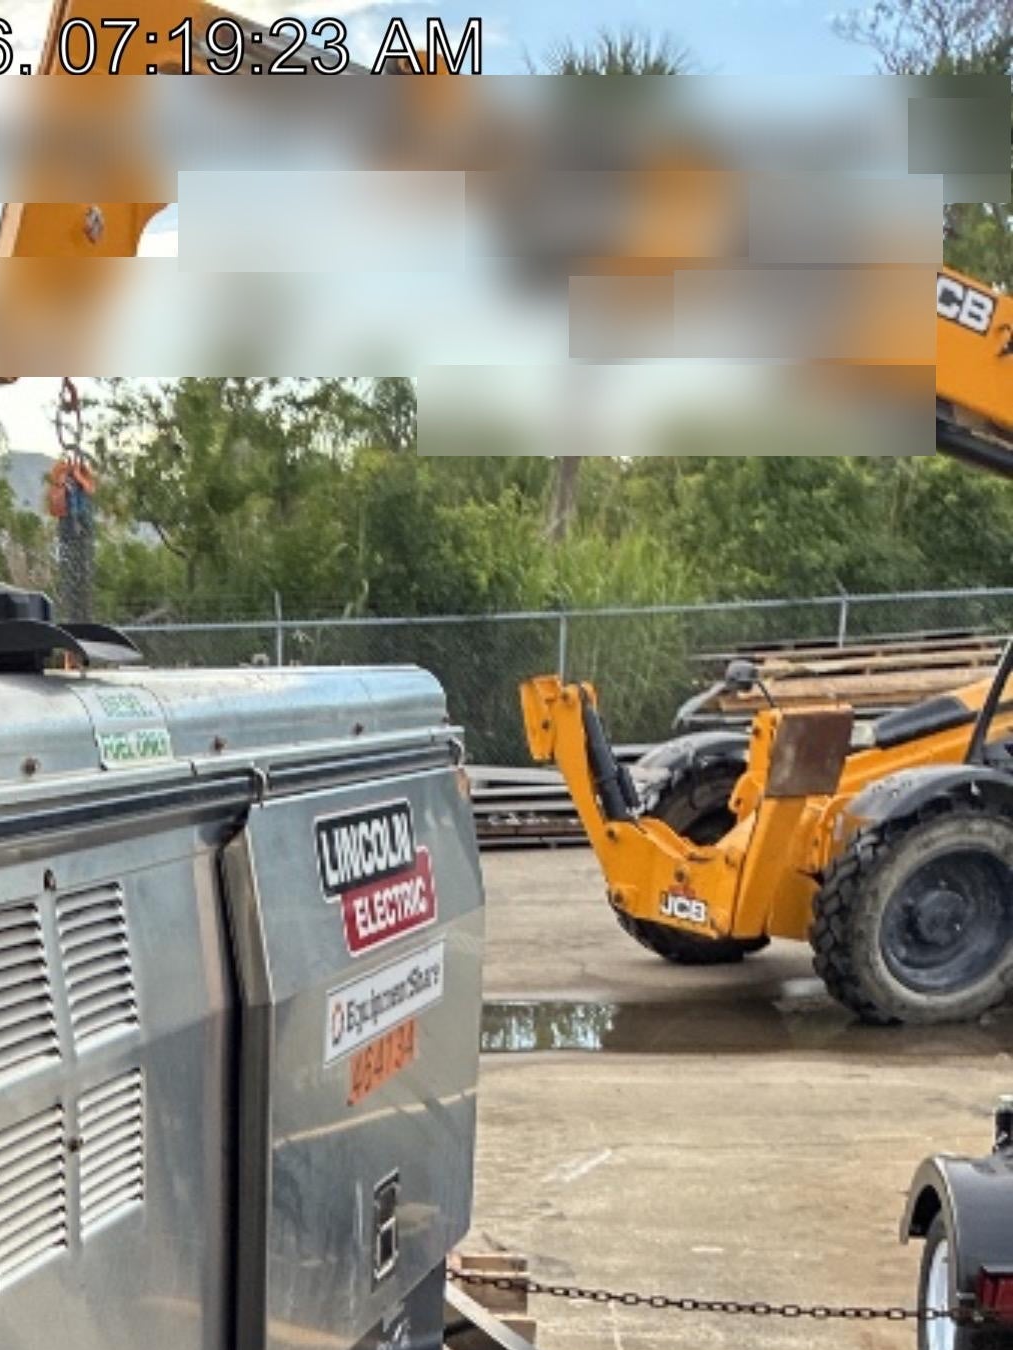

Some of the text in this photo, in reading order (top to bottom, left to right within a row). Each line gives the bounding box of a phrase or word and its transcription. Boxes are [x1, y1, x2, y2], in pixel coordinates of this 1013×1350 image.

[937, 276, 994, 332] CB
[320, 813, 413, 886] LINCOLN
[352, 880, 428, 939] ELECTRIC
[660, 892, 706, 923] JCB
[346, 964, 441, 1034] EquipmentShare
